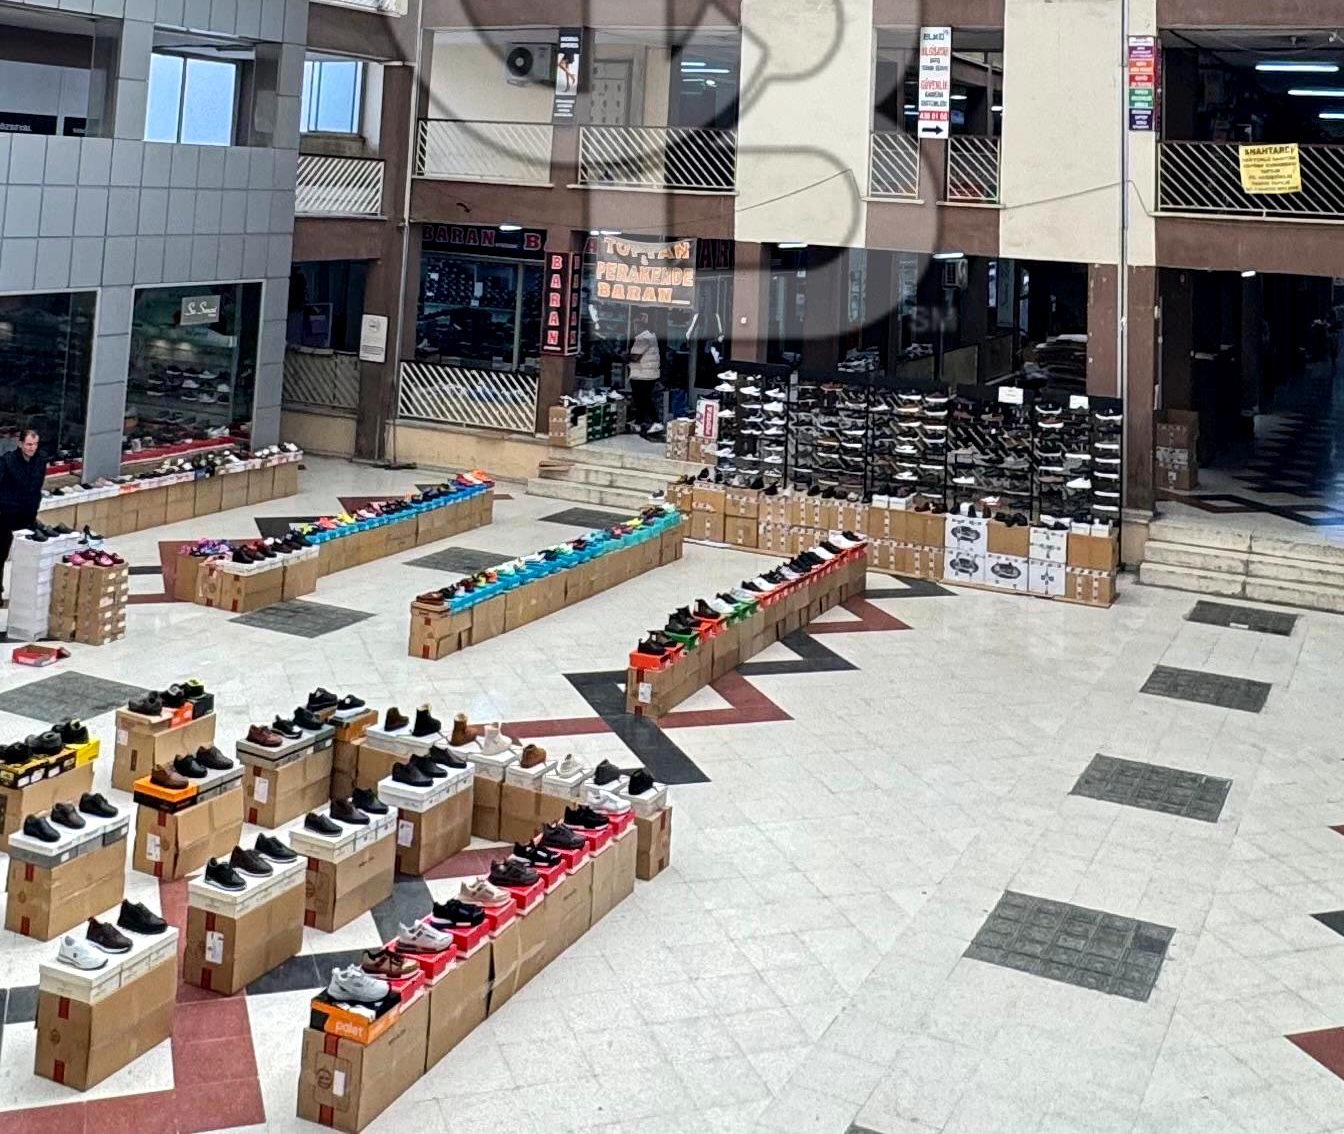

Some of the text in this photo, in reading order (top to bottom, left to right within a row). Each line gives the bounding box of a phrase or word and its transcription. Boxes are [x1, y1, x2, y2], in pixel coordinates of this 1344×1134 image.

[596, 260, 694, 287] PERAKENDE
[546, 255, 563, 345] BARAN
[597, 281, 673, 303] BARAN
